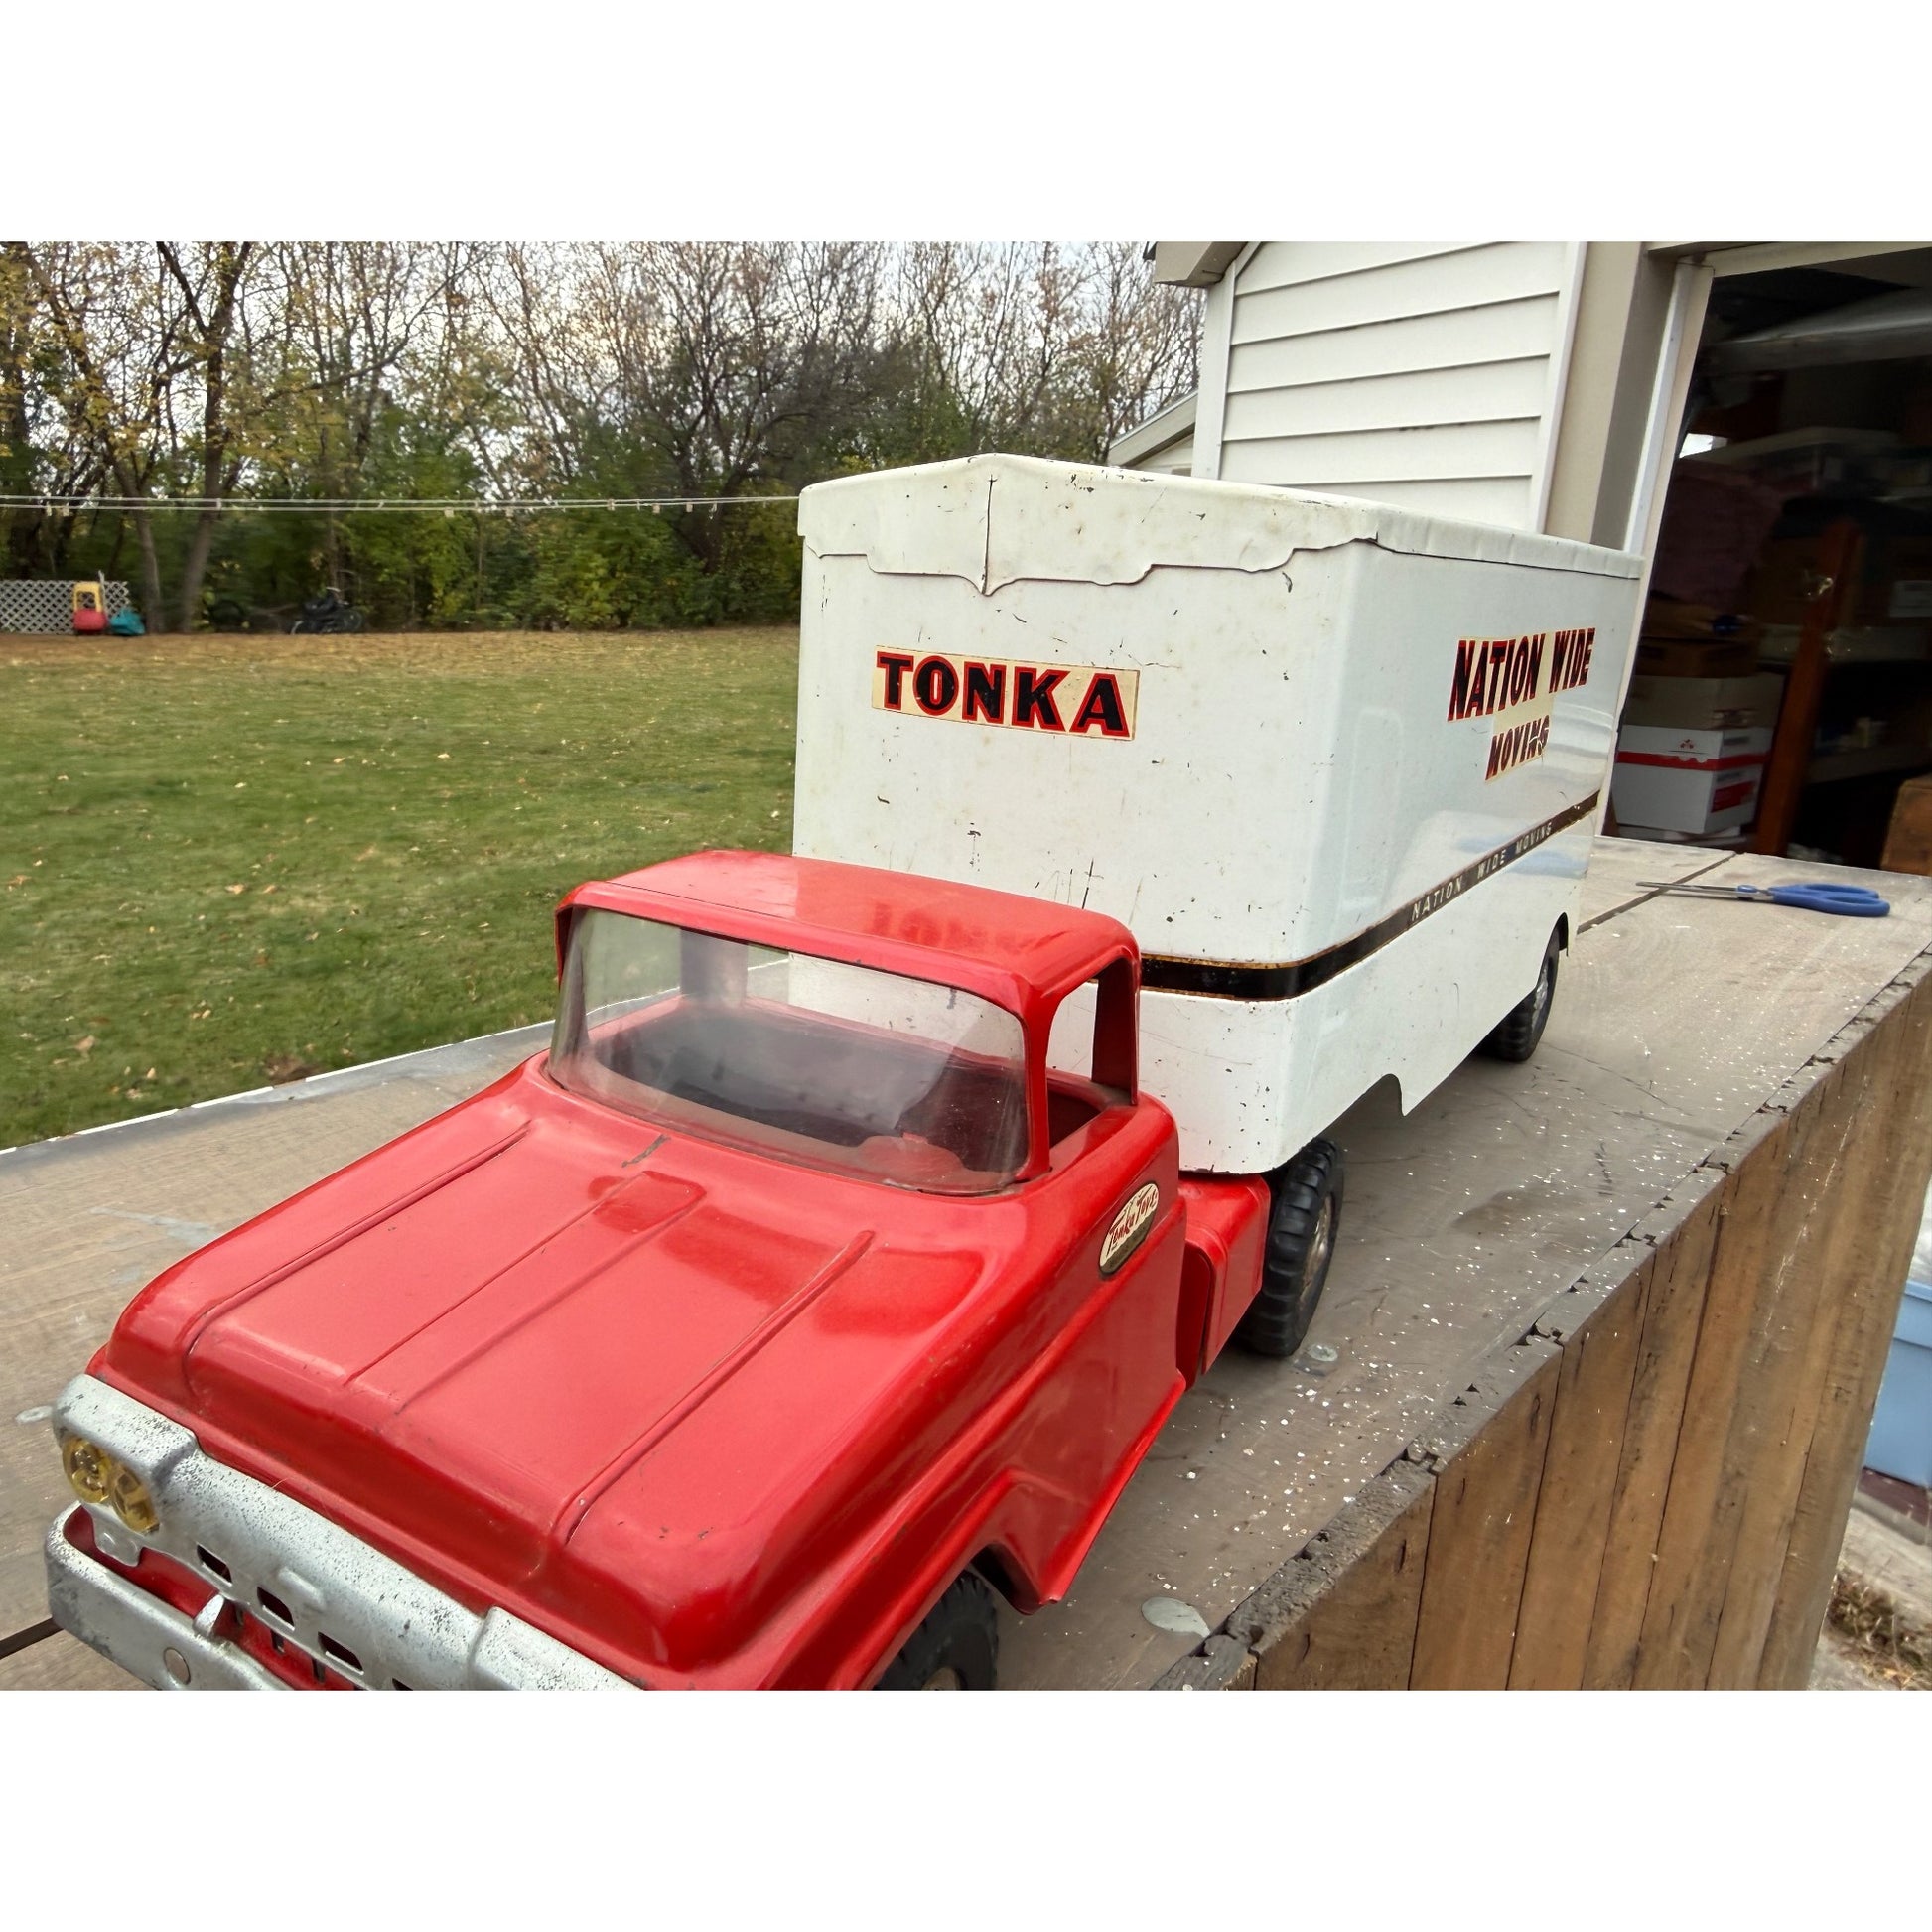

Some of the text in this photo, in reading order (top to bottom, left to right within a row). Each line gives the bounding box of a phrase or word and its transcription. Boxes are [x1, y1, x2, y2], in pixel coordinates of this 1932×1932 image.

[877, 651, 1130, 738] TONKA
[1448, 627, 1596, 722] NATION WIDE
[1485, 715, 1550, 780] MOVING
[1412, 822, 1553, 921] NATION WIDE MOVING
